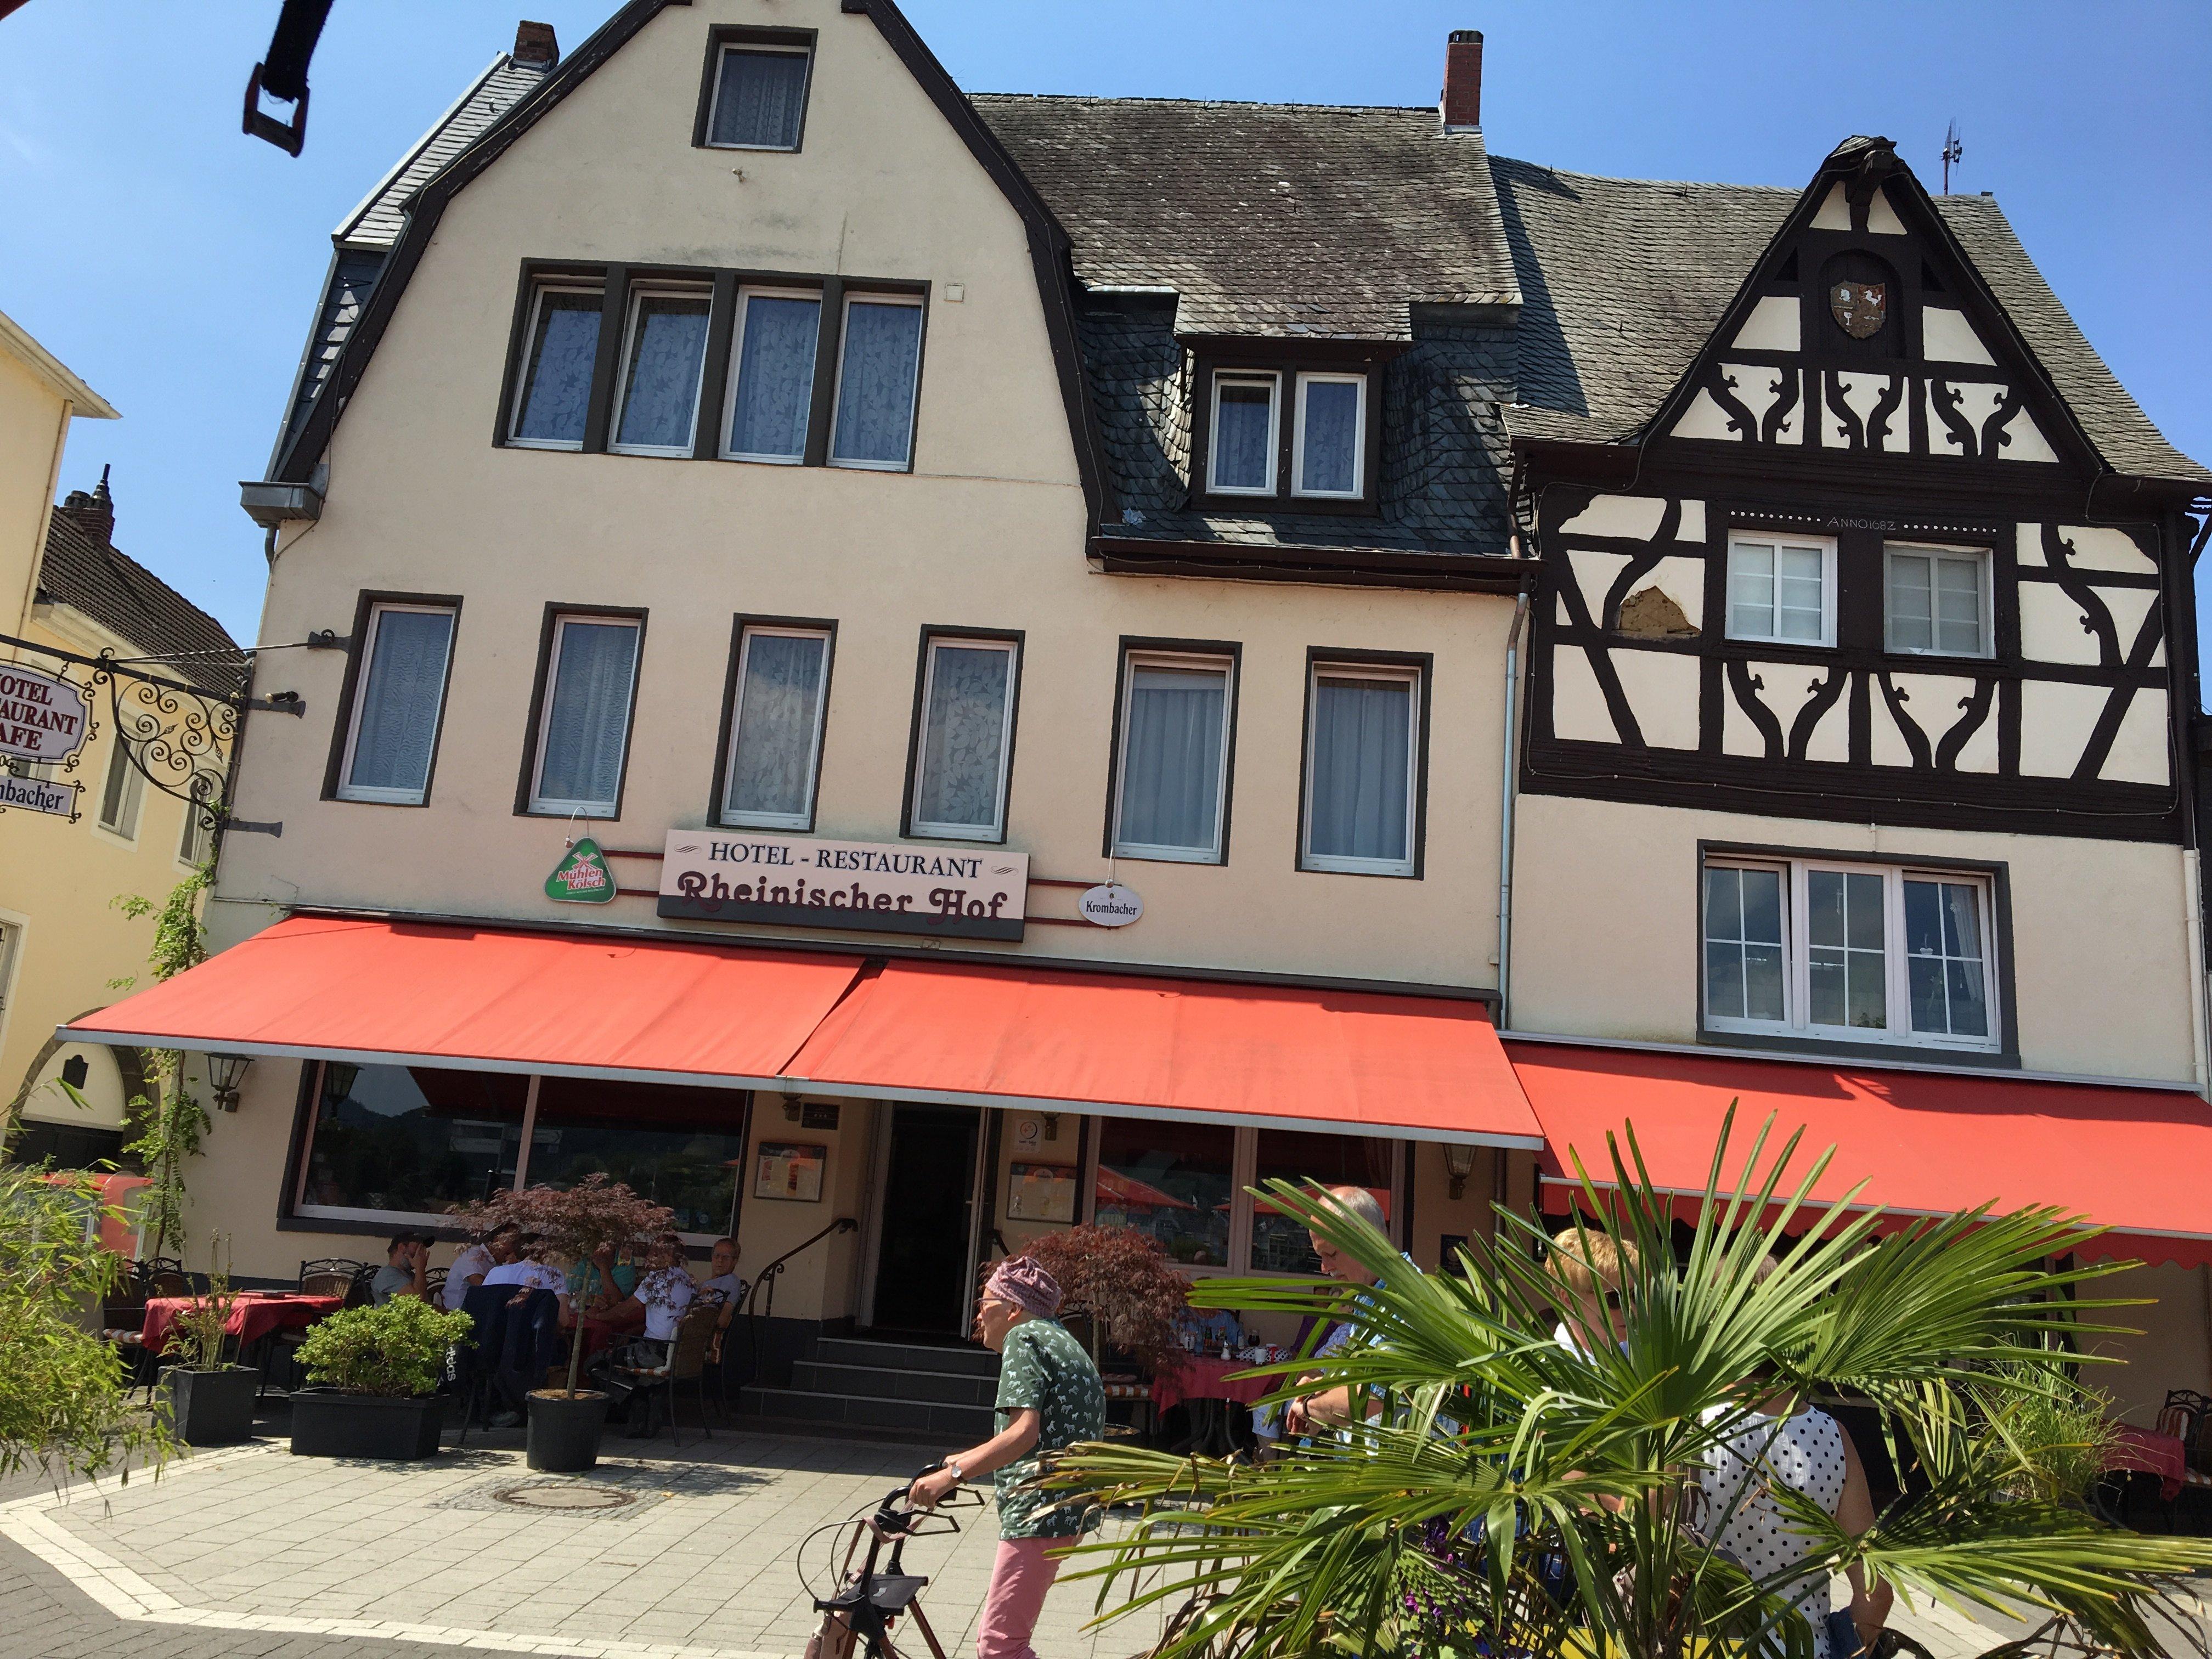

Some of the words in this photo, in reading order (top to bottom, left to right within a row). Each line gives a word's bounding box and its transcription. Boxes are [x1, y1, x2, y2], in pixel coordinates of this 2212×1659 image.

[0, 673, 53, 706] OTEL
[0, 698, 78, 736] AURANT
[557, 868, 603, 881] Mühlen
[708, 842, 794, 866] HOTEL
[816, 849, 983, 878] RESTAURANT
[568, 877, 606, 889] Kölsch
[677, 871, 913, 914] Rheinischer
[927, 887, 1008, 926] Hof
[1086, 900, 1137, 915] Krombacher
